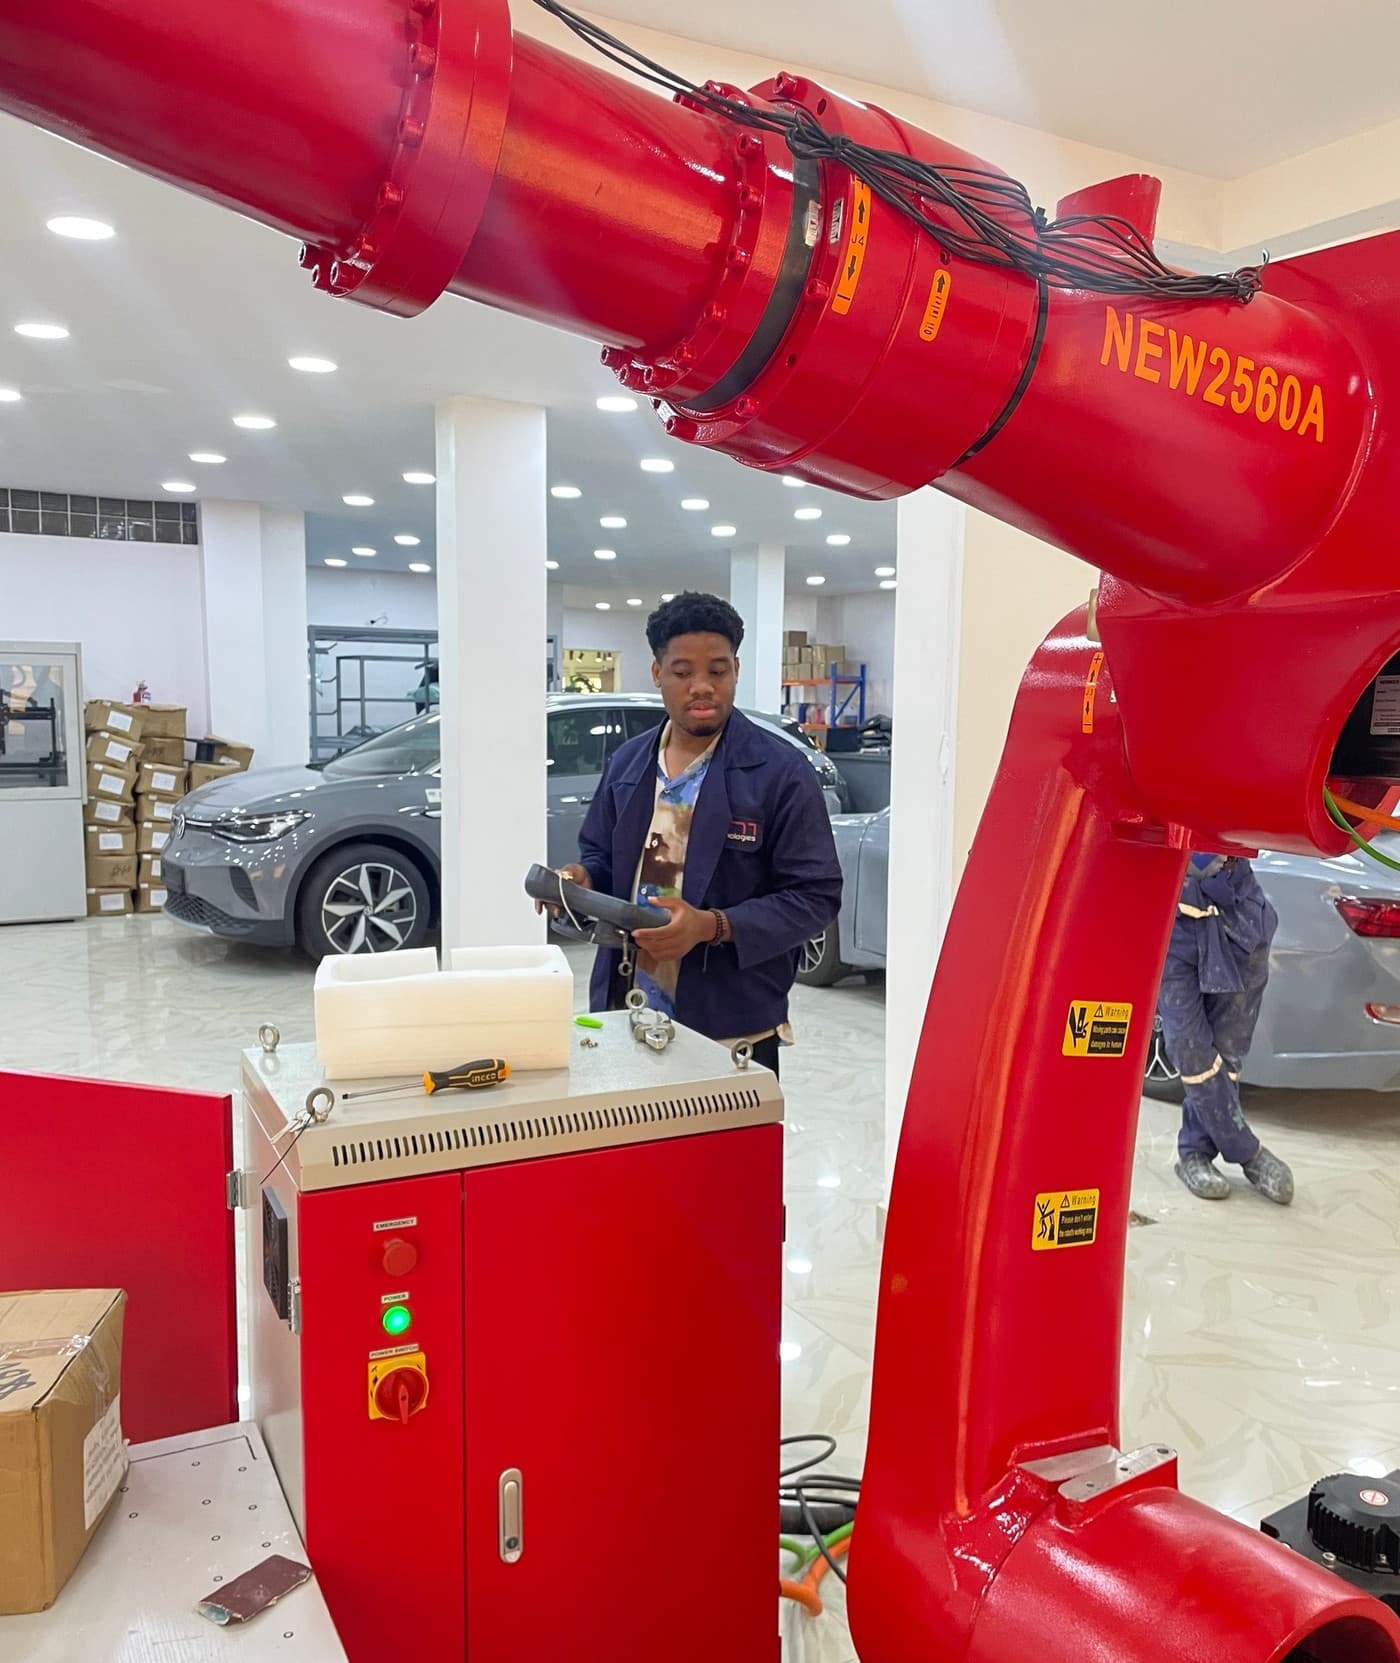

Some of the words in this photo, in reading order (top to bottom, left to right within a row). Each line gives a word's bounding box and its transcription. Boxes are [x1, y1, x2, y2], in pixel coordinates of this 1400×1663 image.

[851, 233, 865, 247] J4
[923, 322, 935, 336] Oil
[1100, 305, 1325, 443] NEW2560A
[1105, 1006, 1129, 1020] Warning
[1071, 1195, 1096, 1206] Warning
[376, 1219, 414, 1229] EMERGENCY
[383, 1293, 406, 1302] POWER
[371, 1349, 393, 1357] POWER
[395, 1345, 418, 1353] SWITCH
